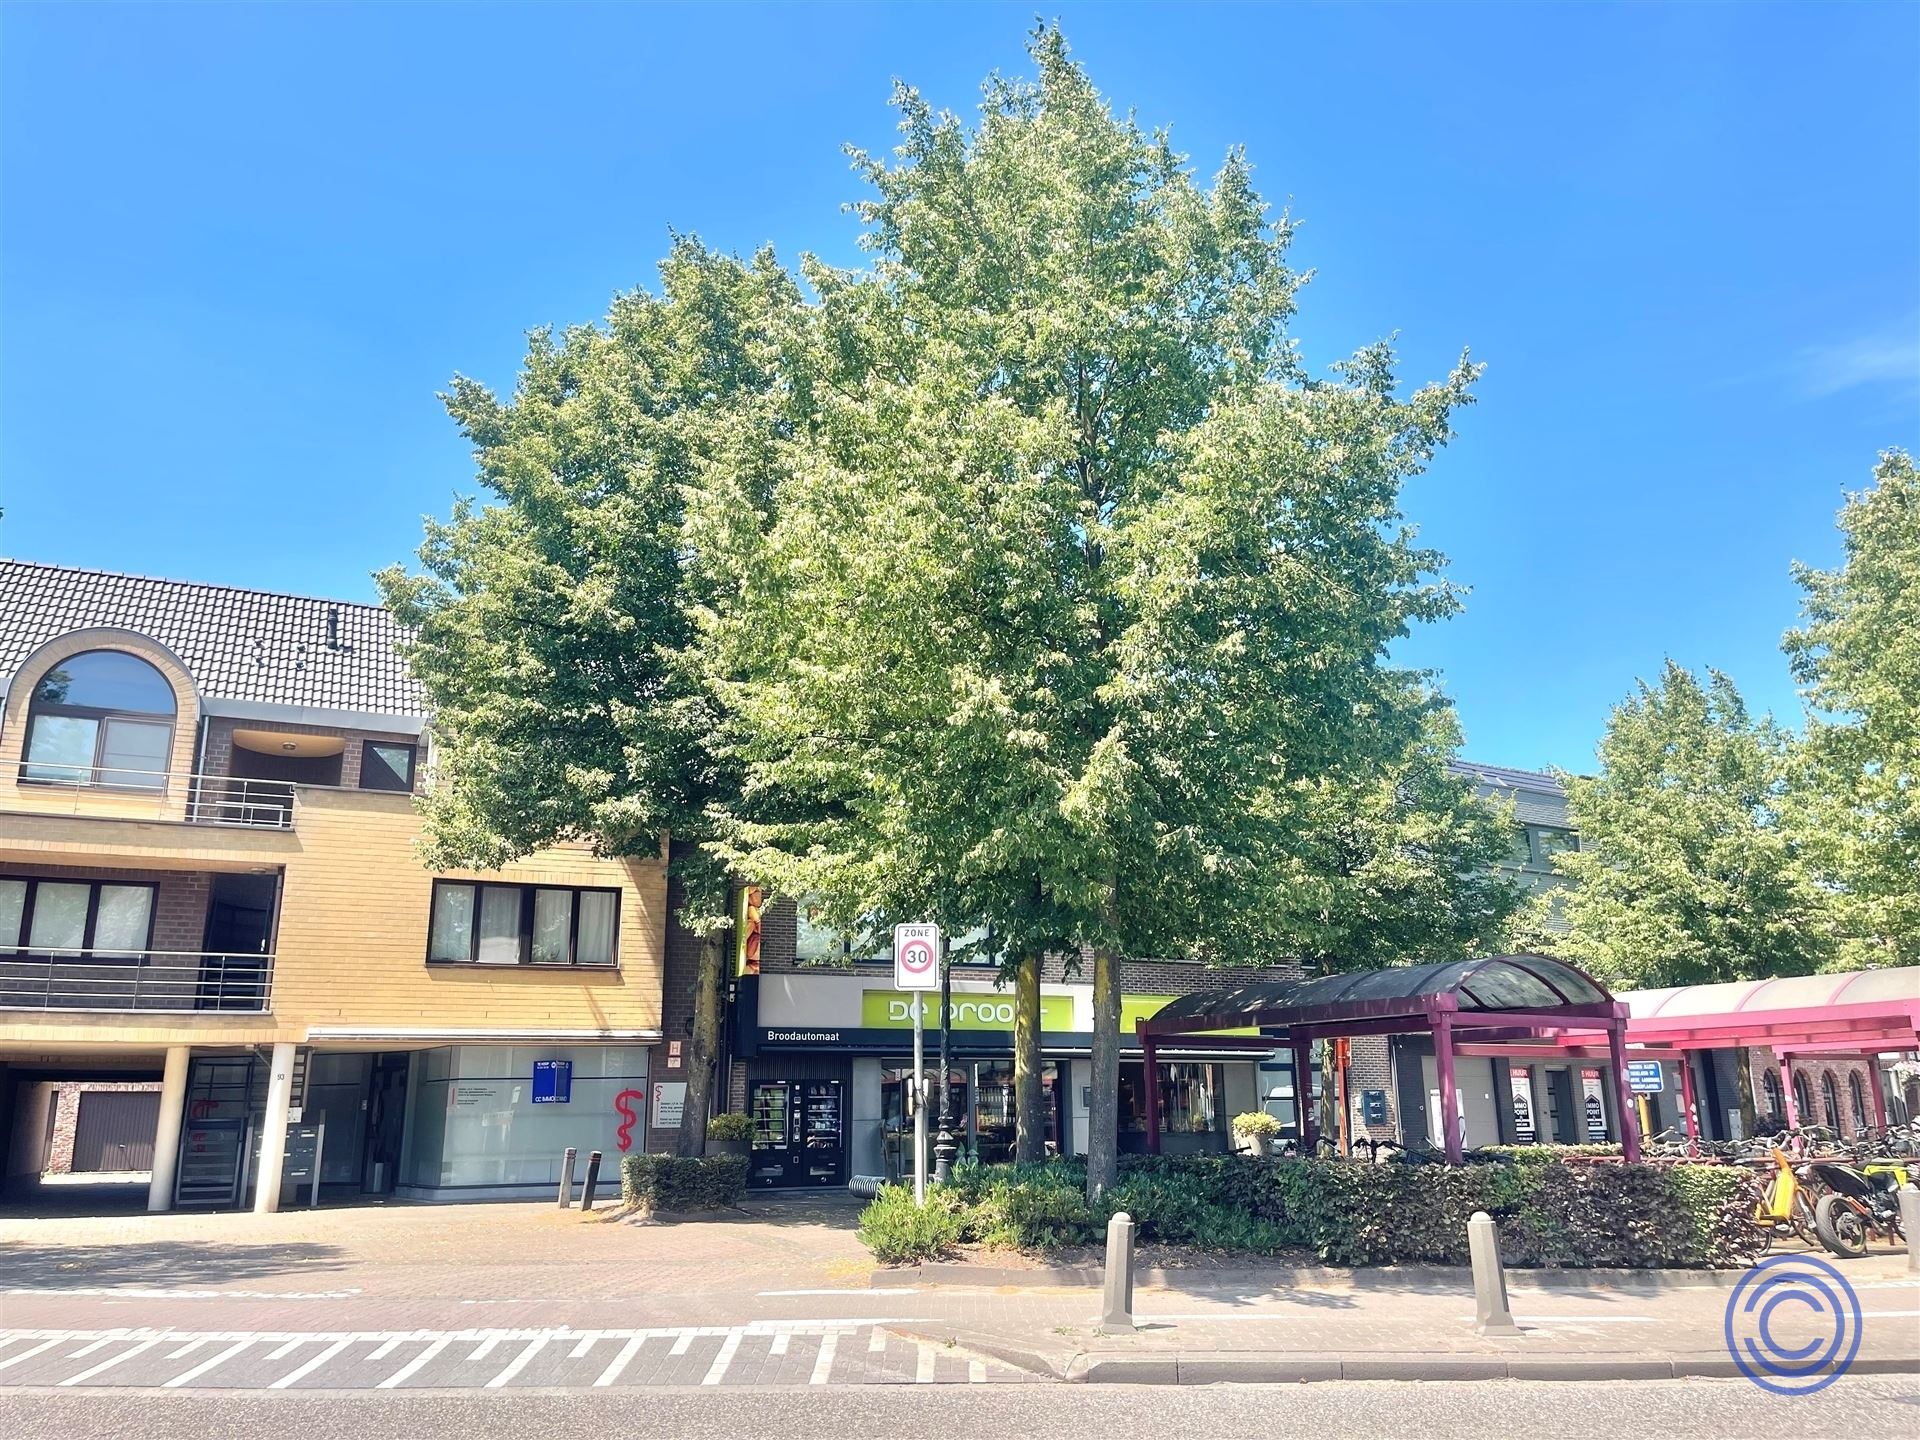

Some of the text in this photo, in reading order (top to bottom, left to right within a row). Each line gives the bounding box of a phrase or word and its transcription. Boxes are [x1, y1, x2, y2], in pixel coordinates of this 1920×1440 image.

[904, 928, 930, 937] ZONE
[907, 950, 928, 964] 30
[767, 1030, 840, 1042] Broodautomaat
